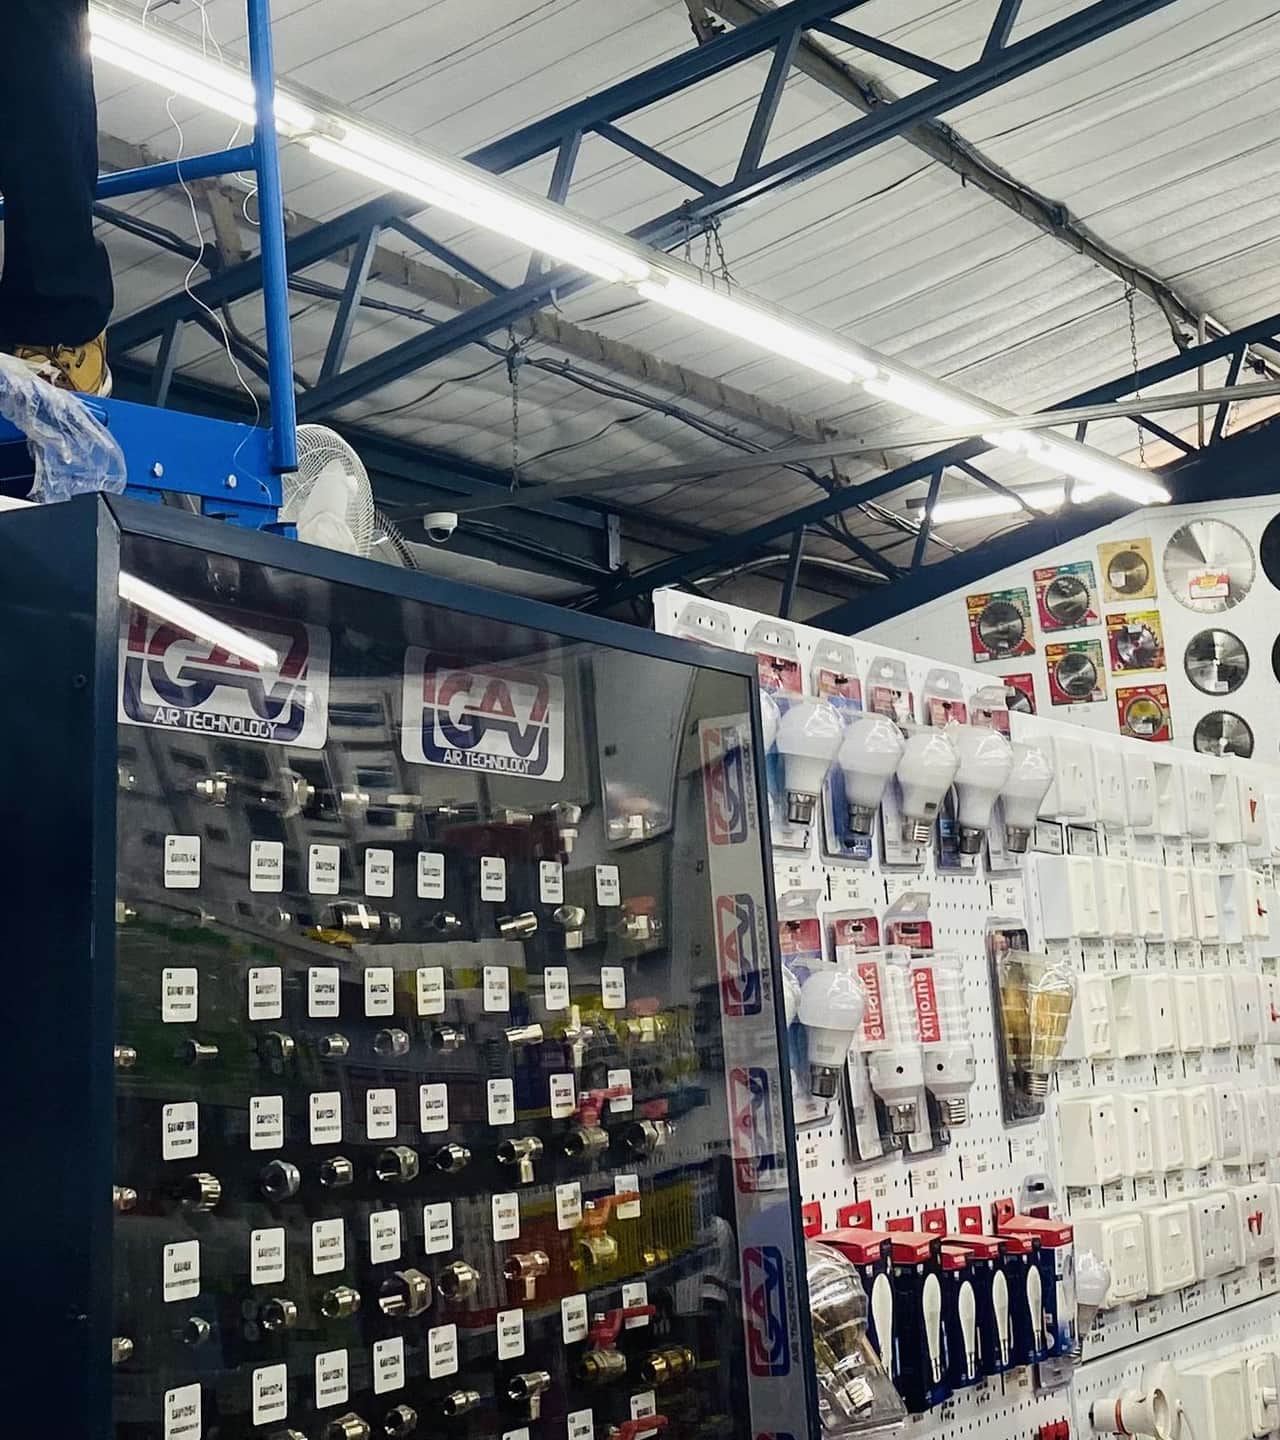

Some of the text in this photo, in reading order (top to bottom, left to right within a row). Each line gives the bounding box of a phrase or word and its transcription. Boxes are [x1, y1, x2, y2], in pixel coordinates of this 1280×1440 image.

[153, 706, 278, 739] AIR TECHNOLOGY
[444, 748, 530, 774] AIR TECHNOLOGY
[915, 972, 937, 1038] eurolux
